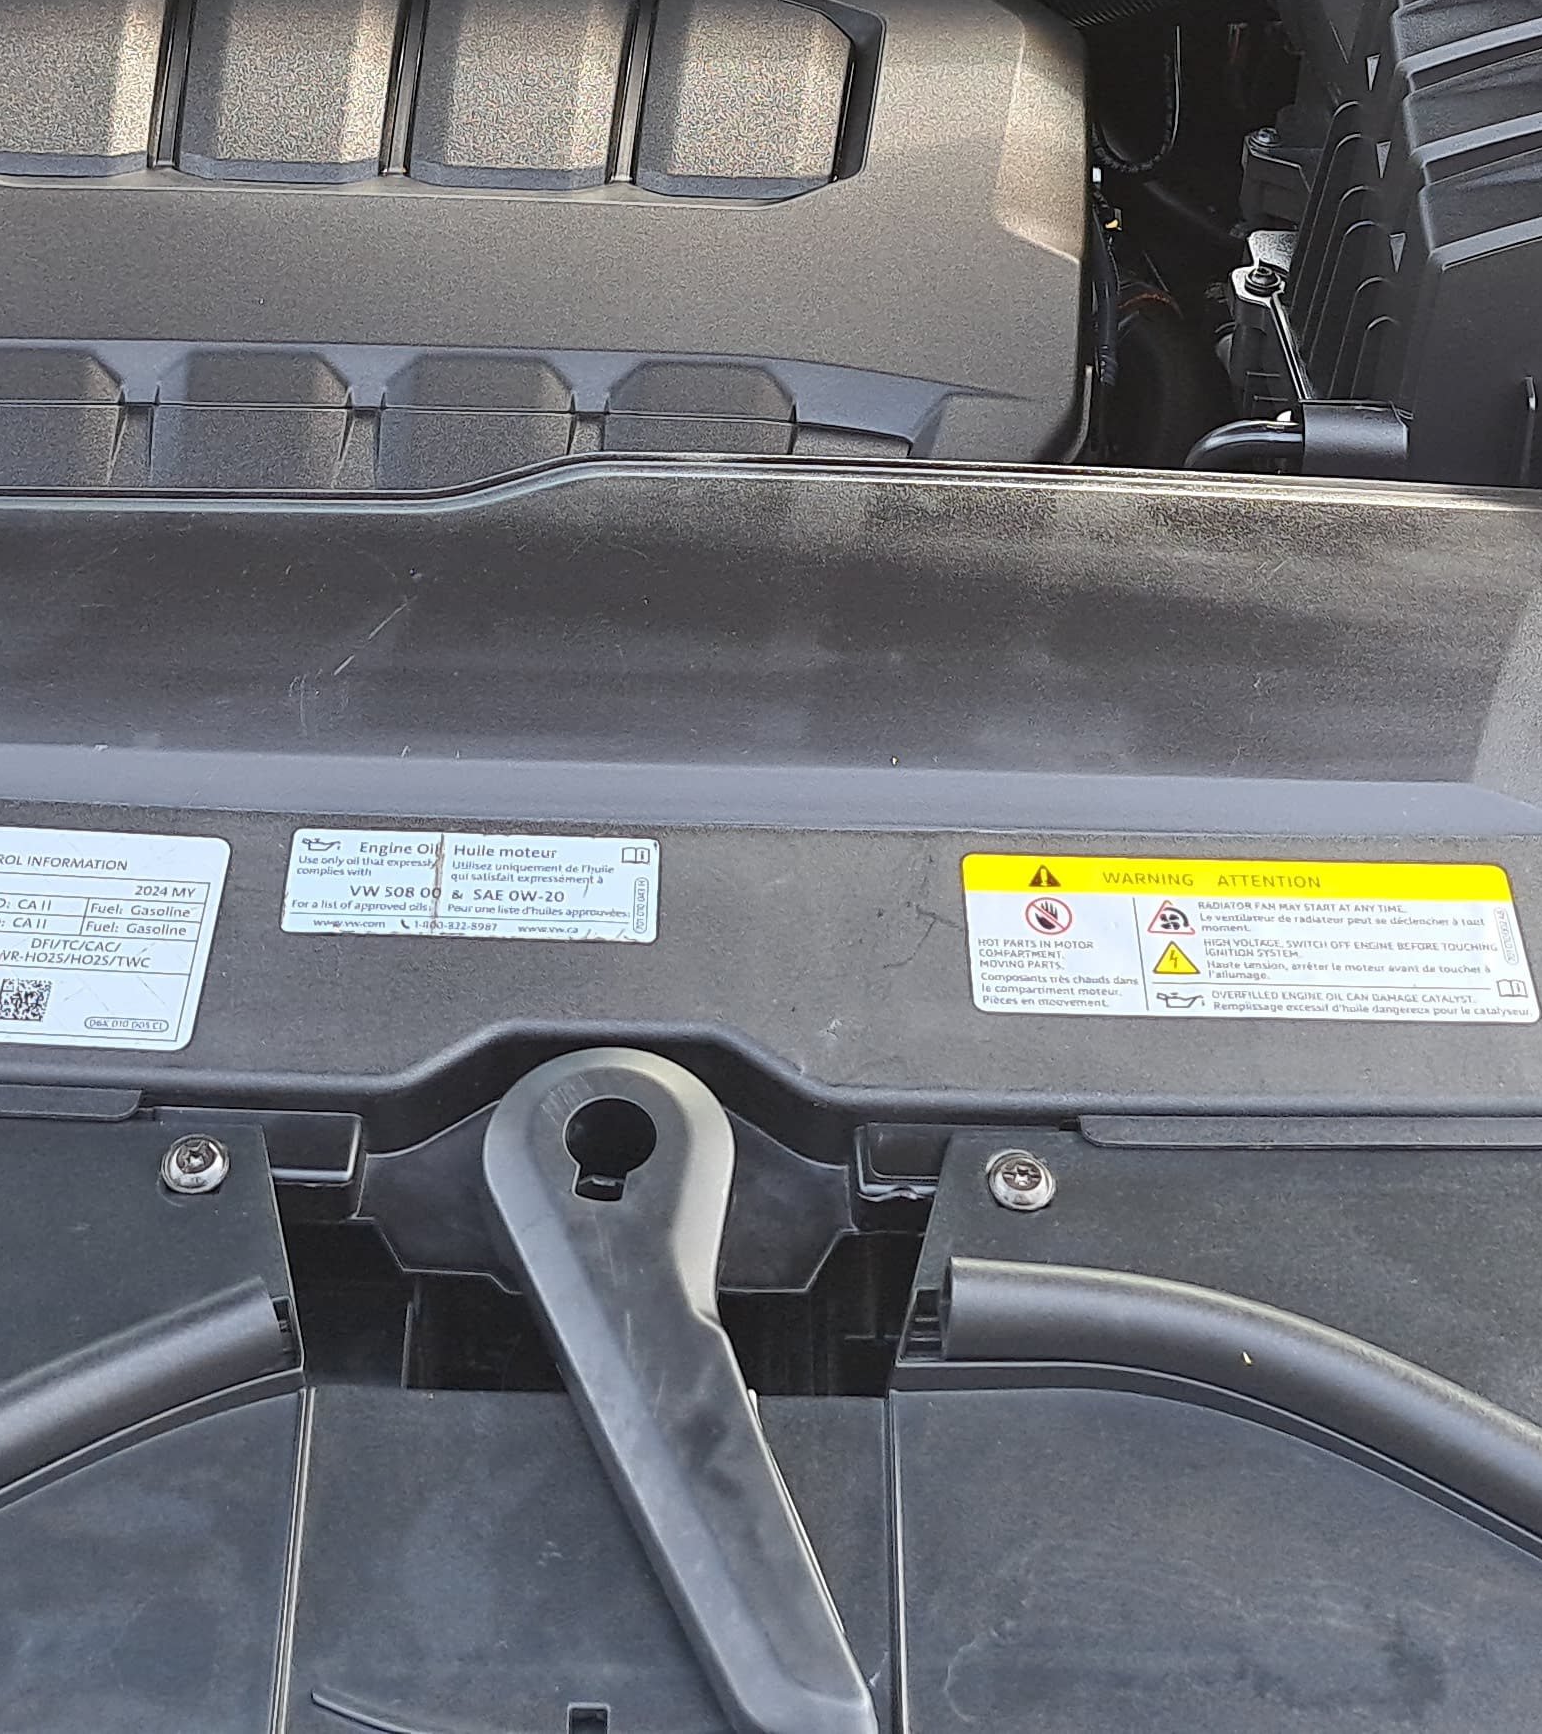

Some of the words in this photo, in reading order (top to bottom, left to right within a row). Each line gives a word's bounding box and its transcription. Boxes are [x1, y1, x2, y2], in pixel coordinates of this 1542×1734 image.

[359, 841, 412, 857] Engine
[417, 843, 439, 854] Oil
[453, 844, 494, 856] Huile
[499, 846, 557, 858] moteur
[26, 855, 128, 870] INFORMATION
[298, 855, 318, 864] Use
[320, 855, 345, 866] only
[346, 856, 359, 865] oil
[361, 857, 383, 866] that
[452, 860, 492, 870] Utilisez
[494, 862, 562, 874] uniquement
[565, 863, 579, 872] de
[296, 867, 344, 876] complies
[346, 868, 372, 876] with
[450, 871, 468, 882] qui
[471, 872, 513, 882] satisfait
[596, 875, 603, 884] à
[1102, 872, 1194, 885] WARNING
[1216, 874, 1321, 888] ATTENTION
[134, 885, 168, 896] 2024
[171, 887, 195, 898] MY
[348, 885, 380, 897] VW
[384, 886, 414, 898] 508
[419, 887, 442, 899] 00
[451, 889, 463, 899] &
[473, 889, 503, 900] SAE
[508, 889, 564, 902] 0W-20
[17, 899, 38, 909] CA
[89, 903, 123, 914] Fuel:
[129, 904, 191, 918] Gasoline
[291, 899, 309, 908] For
[320, 900, 338, 908] list
[339, 900, 352, 909] of
[353, 901, 406, 912] approved
[447, 903, 472, 913] Pour
[474, 906, 495, 914] une
[497, 905, 520, 914] liste
[522, 906, 562, 916] d'huiles
[1197, 901, 1251, 909] RADIATOR
[1254, 902, 1275, 910] FAN
[1278, 902, 1301, 910] MAY
[1303, 903, 1335, 911] START
[1353, 904, 1375, 912] ANY
[1199, 913, 1212, 921] Le
[1214, 914, 1275, 922] ventilateur
[1293, 915, 1343, 923] radiateur
[1346, 916, 1372, 925] peut
[11, 917, 33, 928] CA
[85, 920, 120, 932] Fuel:
[125, 922, 187, 936] Gasoline
[30, 938, 121, 952] DFI/TC/CAC/
[978, 938, 999, 947] HOT
[1003, 939, 1036, 947] PARTS
[1039, 940, 1050, 948] IN
[1054, 940, 1094, 949] MOTOR
[1203, 938, 1230, 946] HIGH
[1285, 940, 1327, 948] SWITCH
[1330, 940, 1350, 949] OFF
[1353, 941, 1394, 949] ENGINE
[1396, 942, 1439, 950] BEFORE
[1442, 943, 1498, 952] TOUCHING
[1204, 948, 1253, 957] IGNITION
[979, 959, 1024, 968] MOVING
[1206, 960, 1240, 969] Haute
[1331, 962, 1341, 970] le
[1387, 964, 1419, 972] avant
[1421, 964, 1436, 972] de
[981, 972, 1047, 982] Composants
[1072, 975, 1110, 983] chauds
[1112, 976, 1138, 984] dans
[981, 983, 991, 992] le
[994, 984, 1074, 995] compartiment
[982, 995, 1018, 1004] Pièces
[1211, 990, 1279, 999] OVERFILLED
[1281, 991, 1322, 1000] ENGINE
[1325, 992, 1343, 1001] OIL
[1346, 992, 1368, 1001] CAN
[1371, 993, 1418, 1002] DAMAGE
[1432, 1006, 1458, 1016] pour
[1460, 1006, 1470, 1014] le
